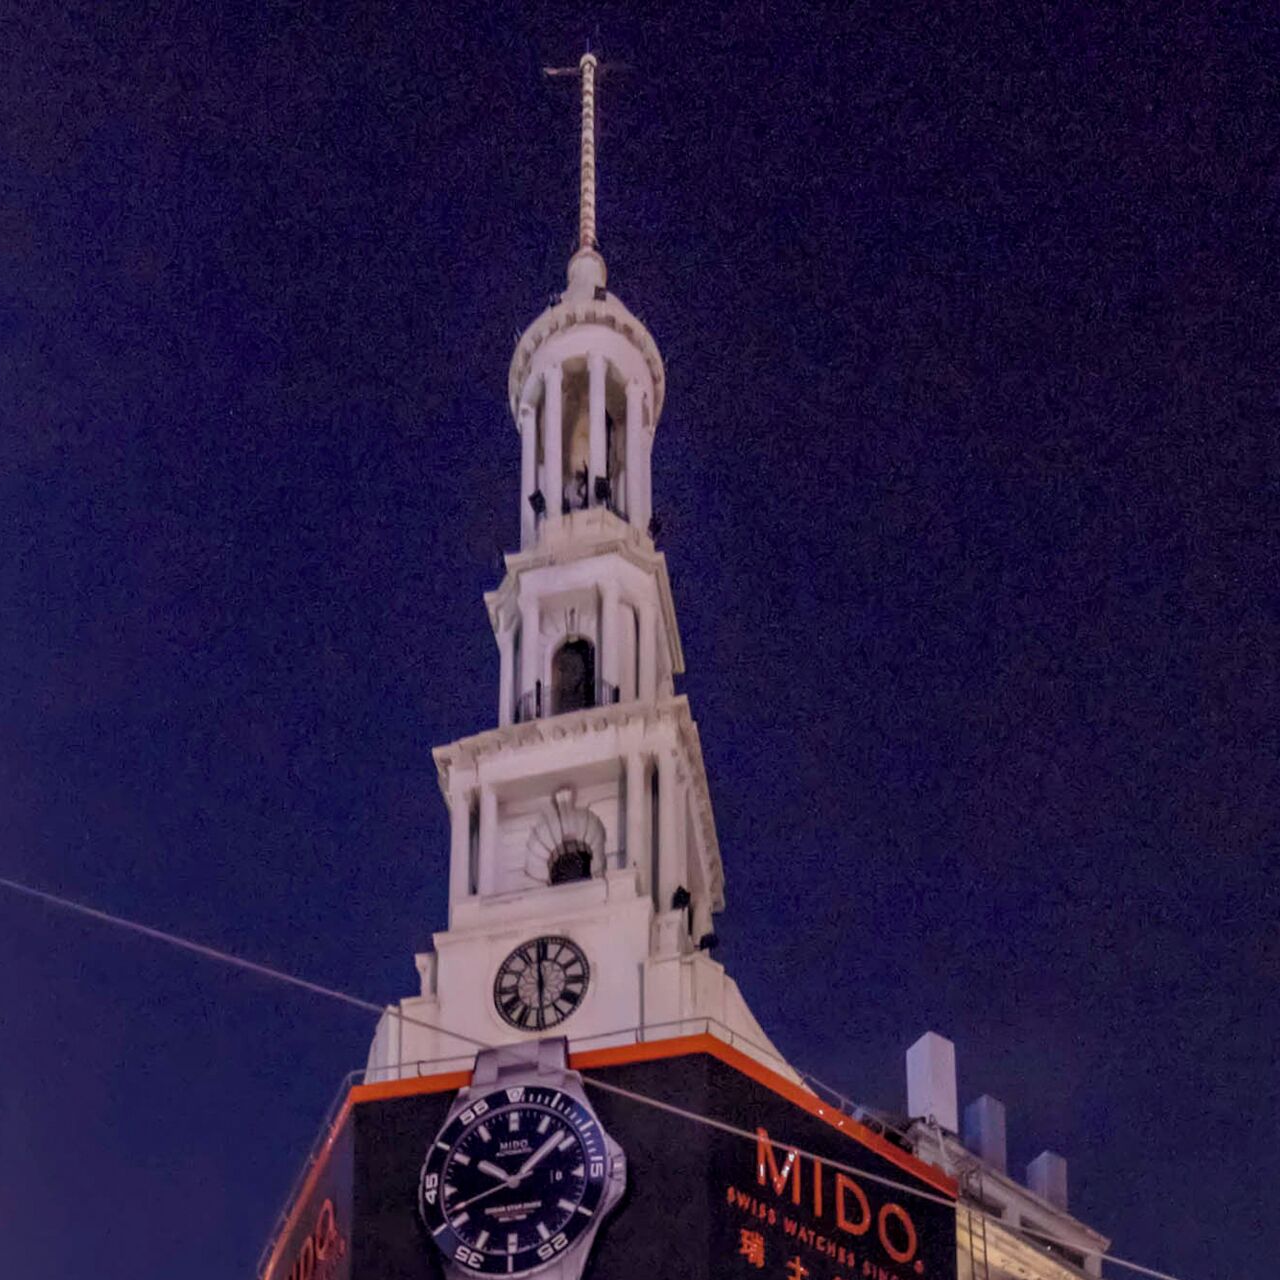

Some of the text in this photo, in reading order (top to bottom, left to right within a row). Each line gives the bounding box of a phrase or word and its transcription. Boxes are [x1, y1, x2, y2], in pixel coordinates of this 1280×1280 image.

[590, 1156, 604, 1178] 15
[424, 1173, 439, 1205] 45
[756, 1127, 918, 1264] MIDO
[453, 1245, 485, 1269] 35
[536, 1232, 569, 1262] 25
[783, 1216, 856, 1269] WATCHES
